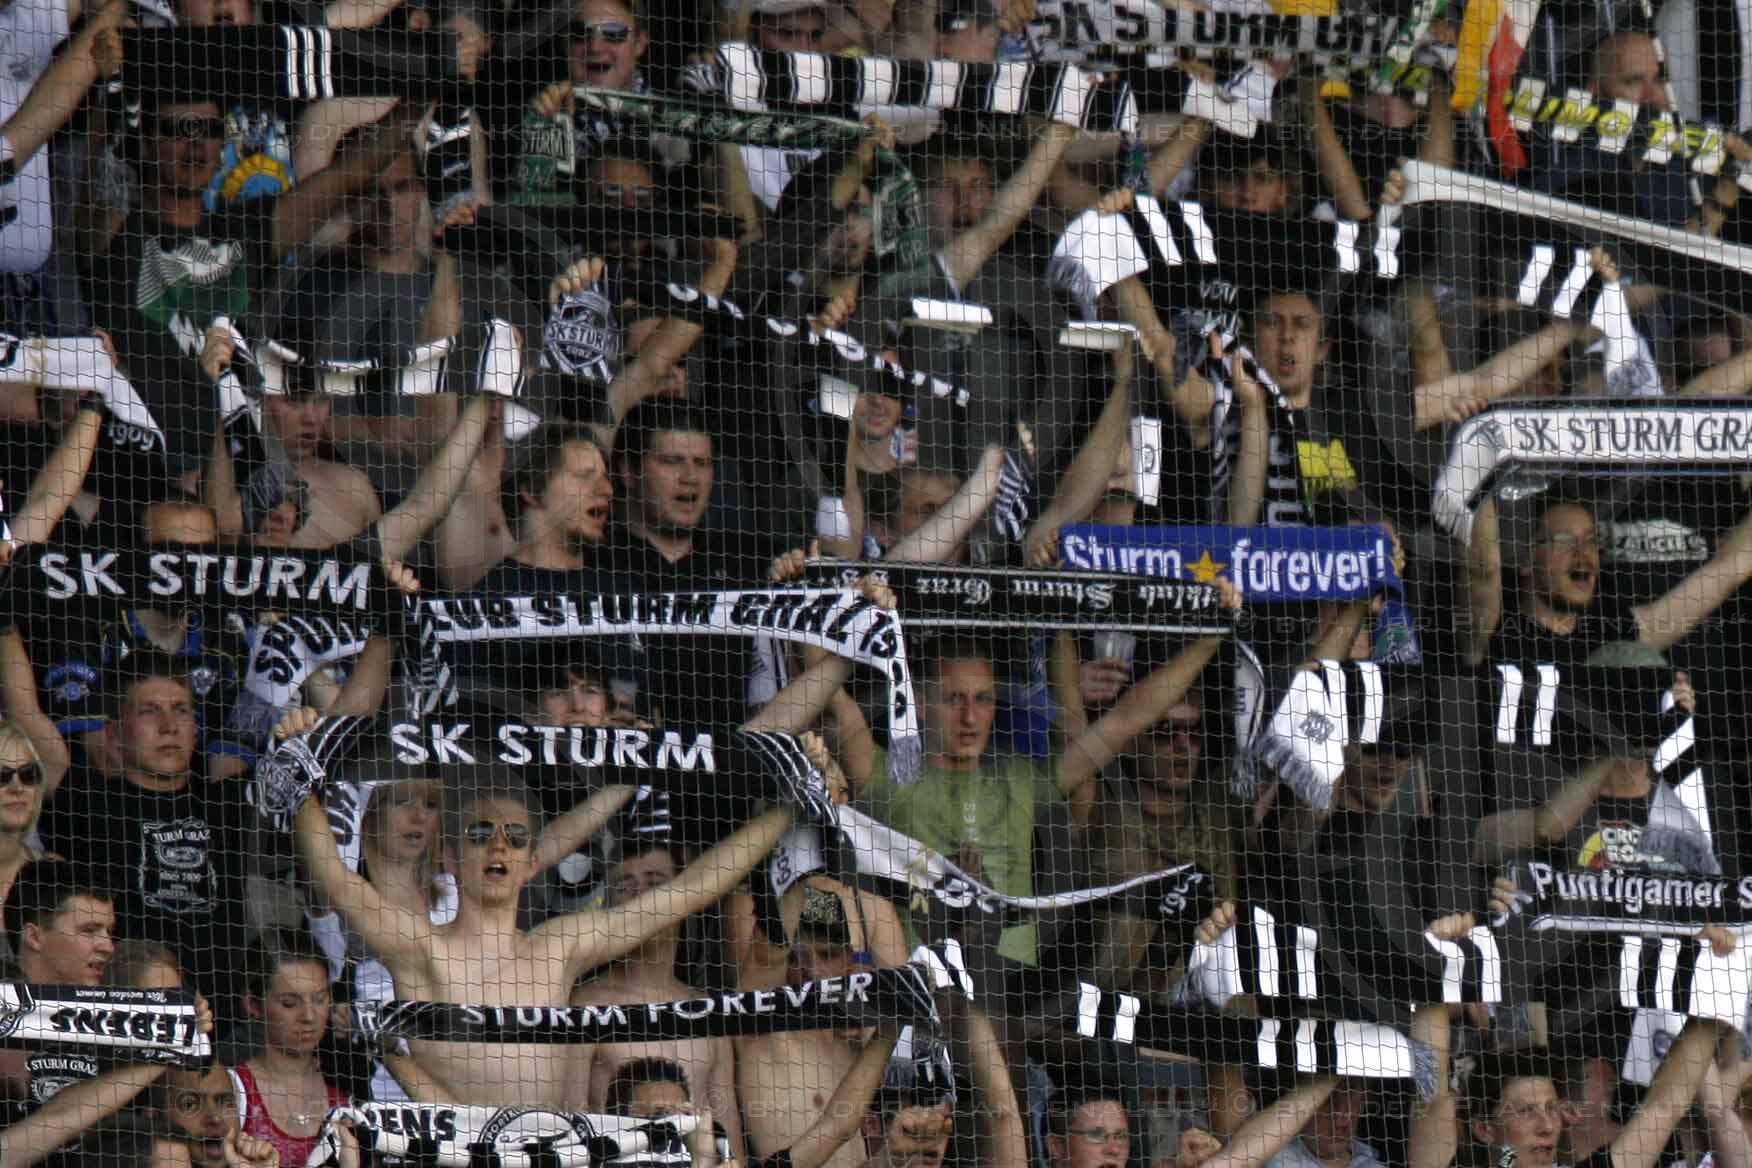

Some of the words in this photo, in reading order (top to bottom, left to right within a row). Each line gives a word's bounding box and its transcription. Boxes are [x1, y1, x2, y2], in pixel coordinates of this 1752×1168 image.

[1513, 417, 1561, 452] SK
[1567, 416, 1683, 452] STURM
[39, 552, 126, 599] SK
[147, 552, 372, 609] STURM
[1230, 535, 1388, 595] forever!
[390, 722, 476, 769] SK
[498, 724, 716, 773] STURM
[1528, 862, 1728, 915] Puntigamer
[649, 972, 873, 1023] FOREVER
[50, 1008, 195, 1048] LEBENS
